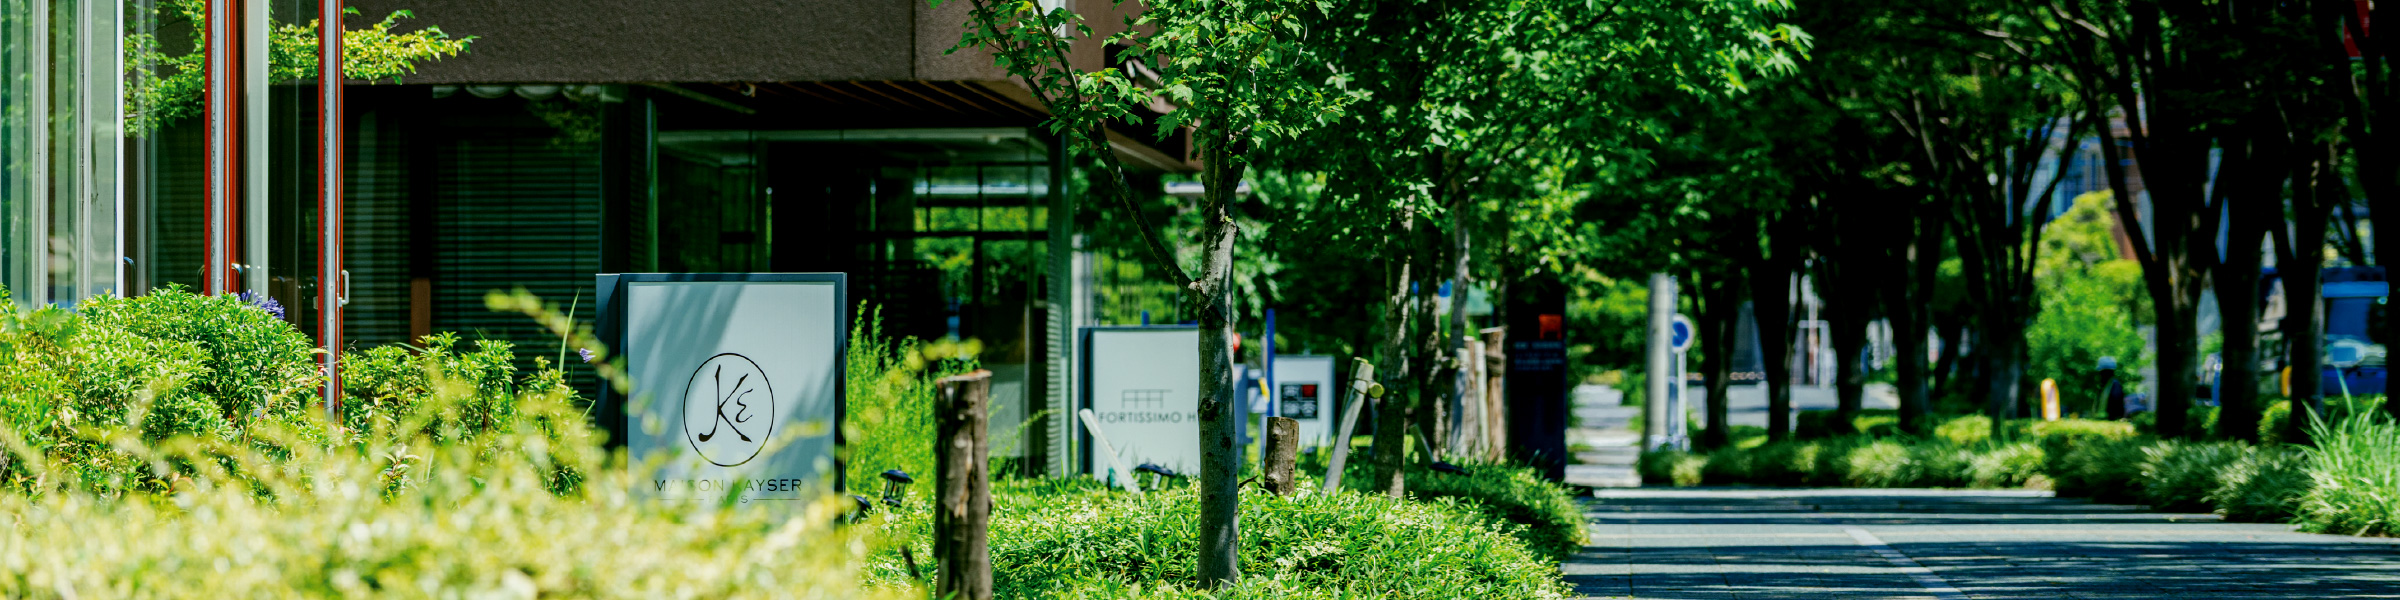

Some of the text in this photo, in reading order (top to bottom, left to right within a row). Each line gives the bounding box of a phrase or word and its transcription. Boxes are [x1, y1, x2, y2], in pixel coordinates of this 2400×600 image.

[1098, 411, 1197, 424] FORTISSIMO H
[654, 479, 724, 492] MASON
